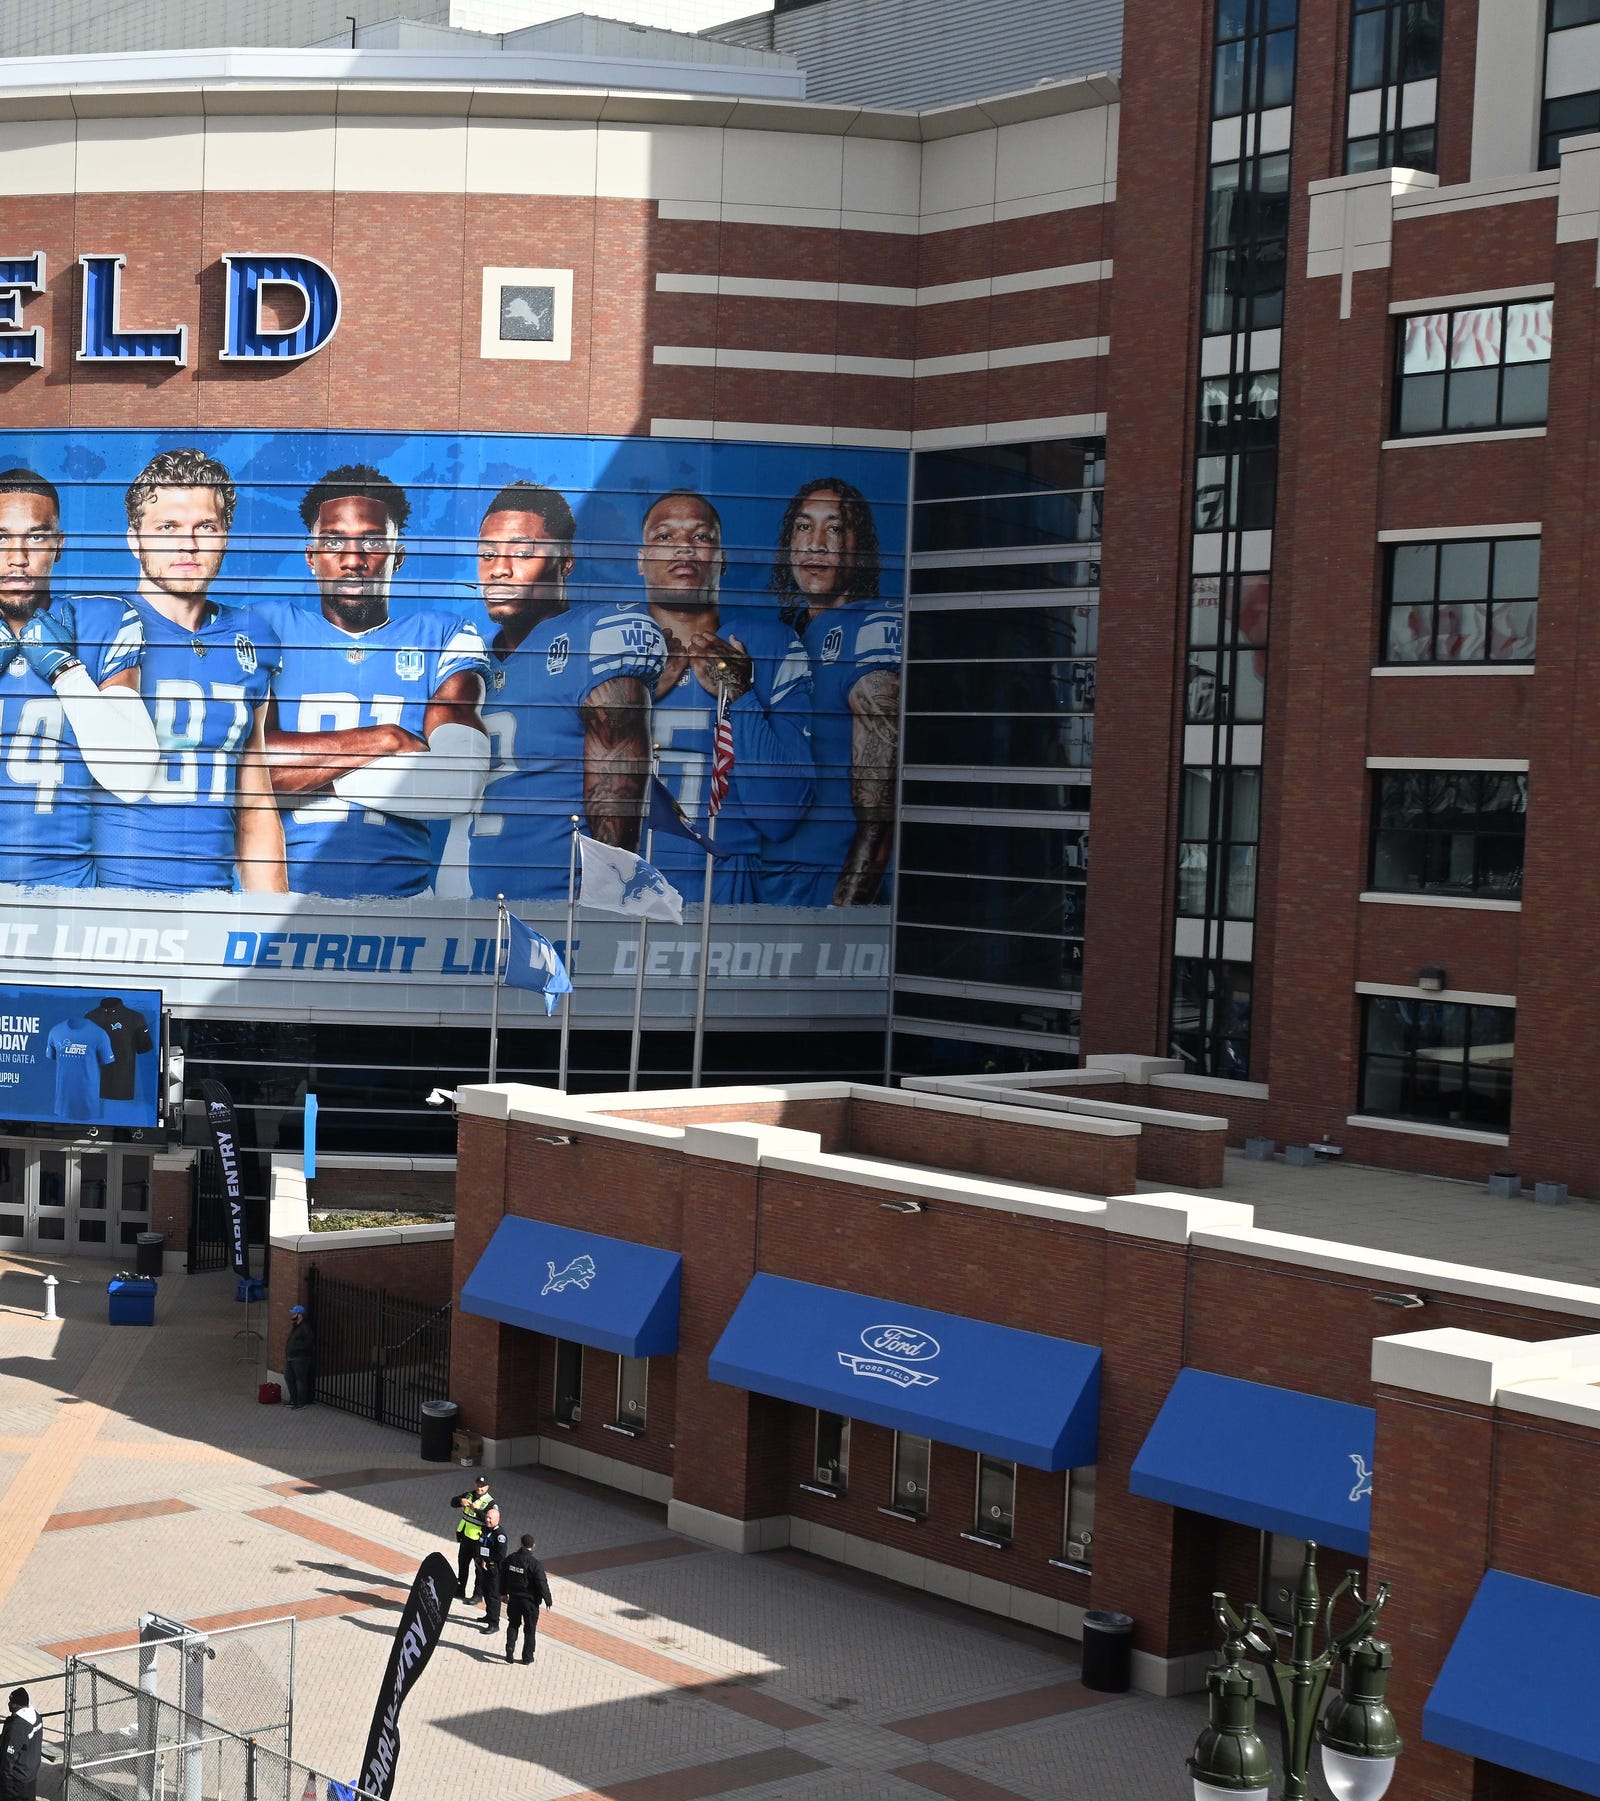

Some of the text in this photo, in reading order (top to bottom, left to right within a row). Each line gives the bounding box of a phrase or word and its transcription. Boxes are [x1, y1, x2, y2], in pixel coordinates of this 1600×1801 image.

[54, 924, 190, 965] LIONS
[224, 931, 425, 973] DETROIT
[614, 939, 806, 977] DETROIT
[12, 1053, 29, 1064] GATE
[30, 1053, 35, 1064] A
[65, 1046, 87, 1055] LIONS
[216, 1131, 240, 1197] ENTRY
[874, 1329, 926, 1356] Ford
[860, 1364, 910, 1382] FORD FIELD
[365, 1704, 398, 1798] EARLY
[395, 1611, 427, 1709] TRY
